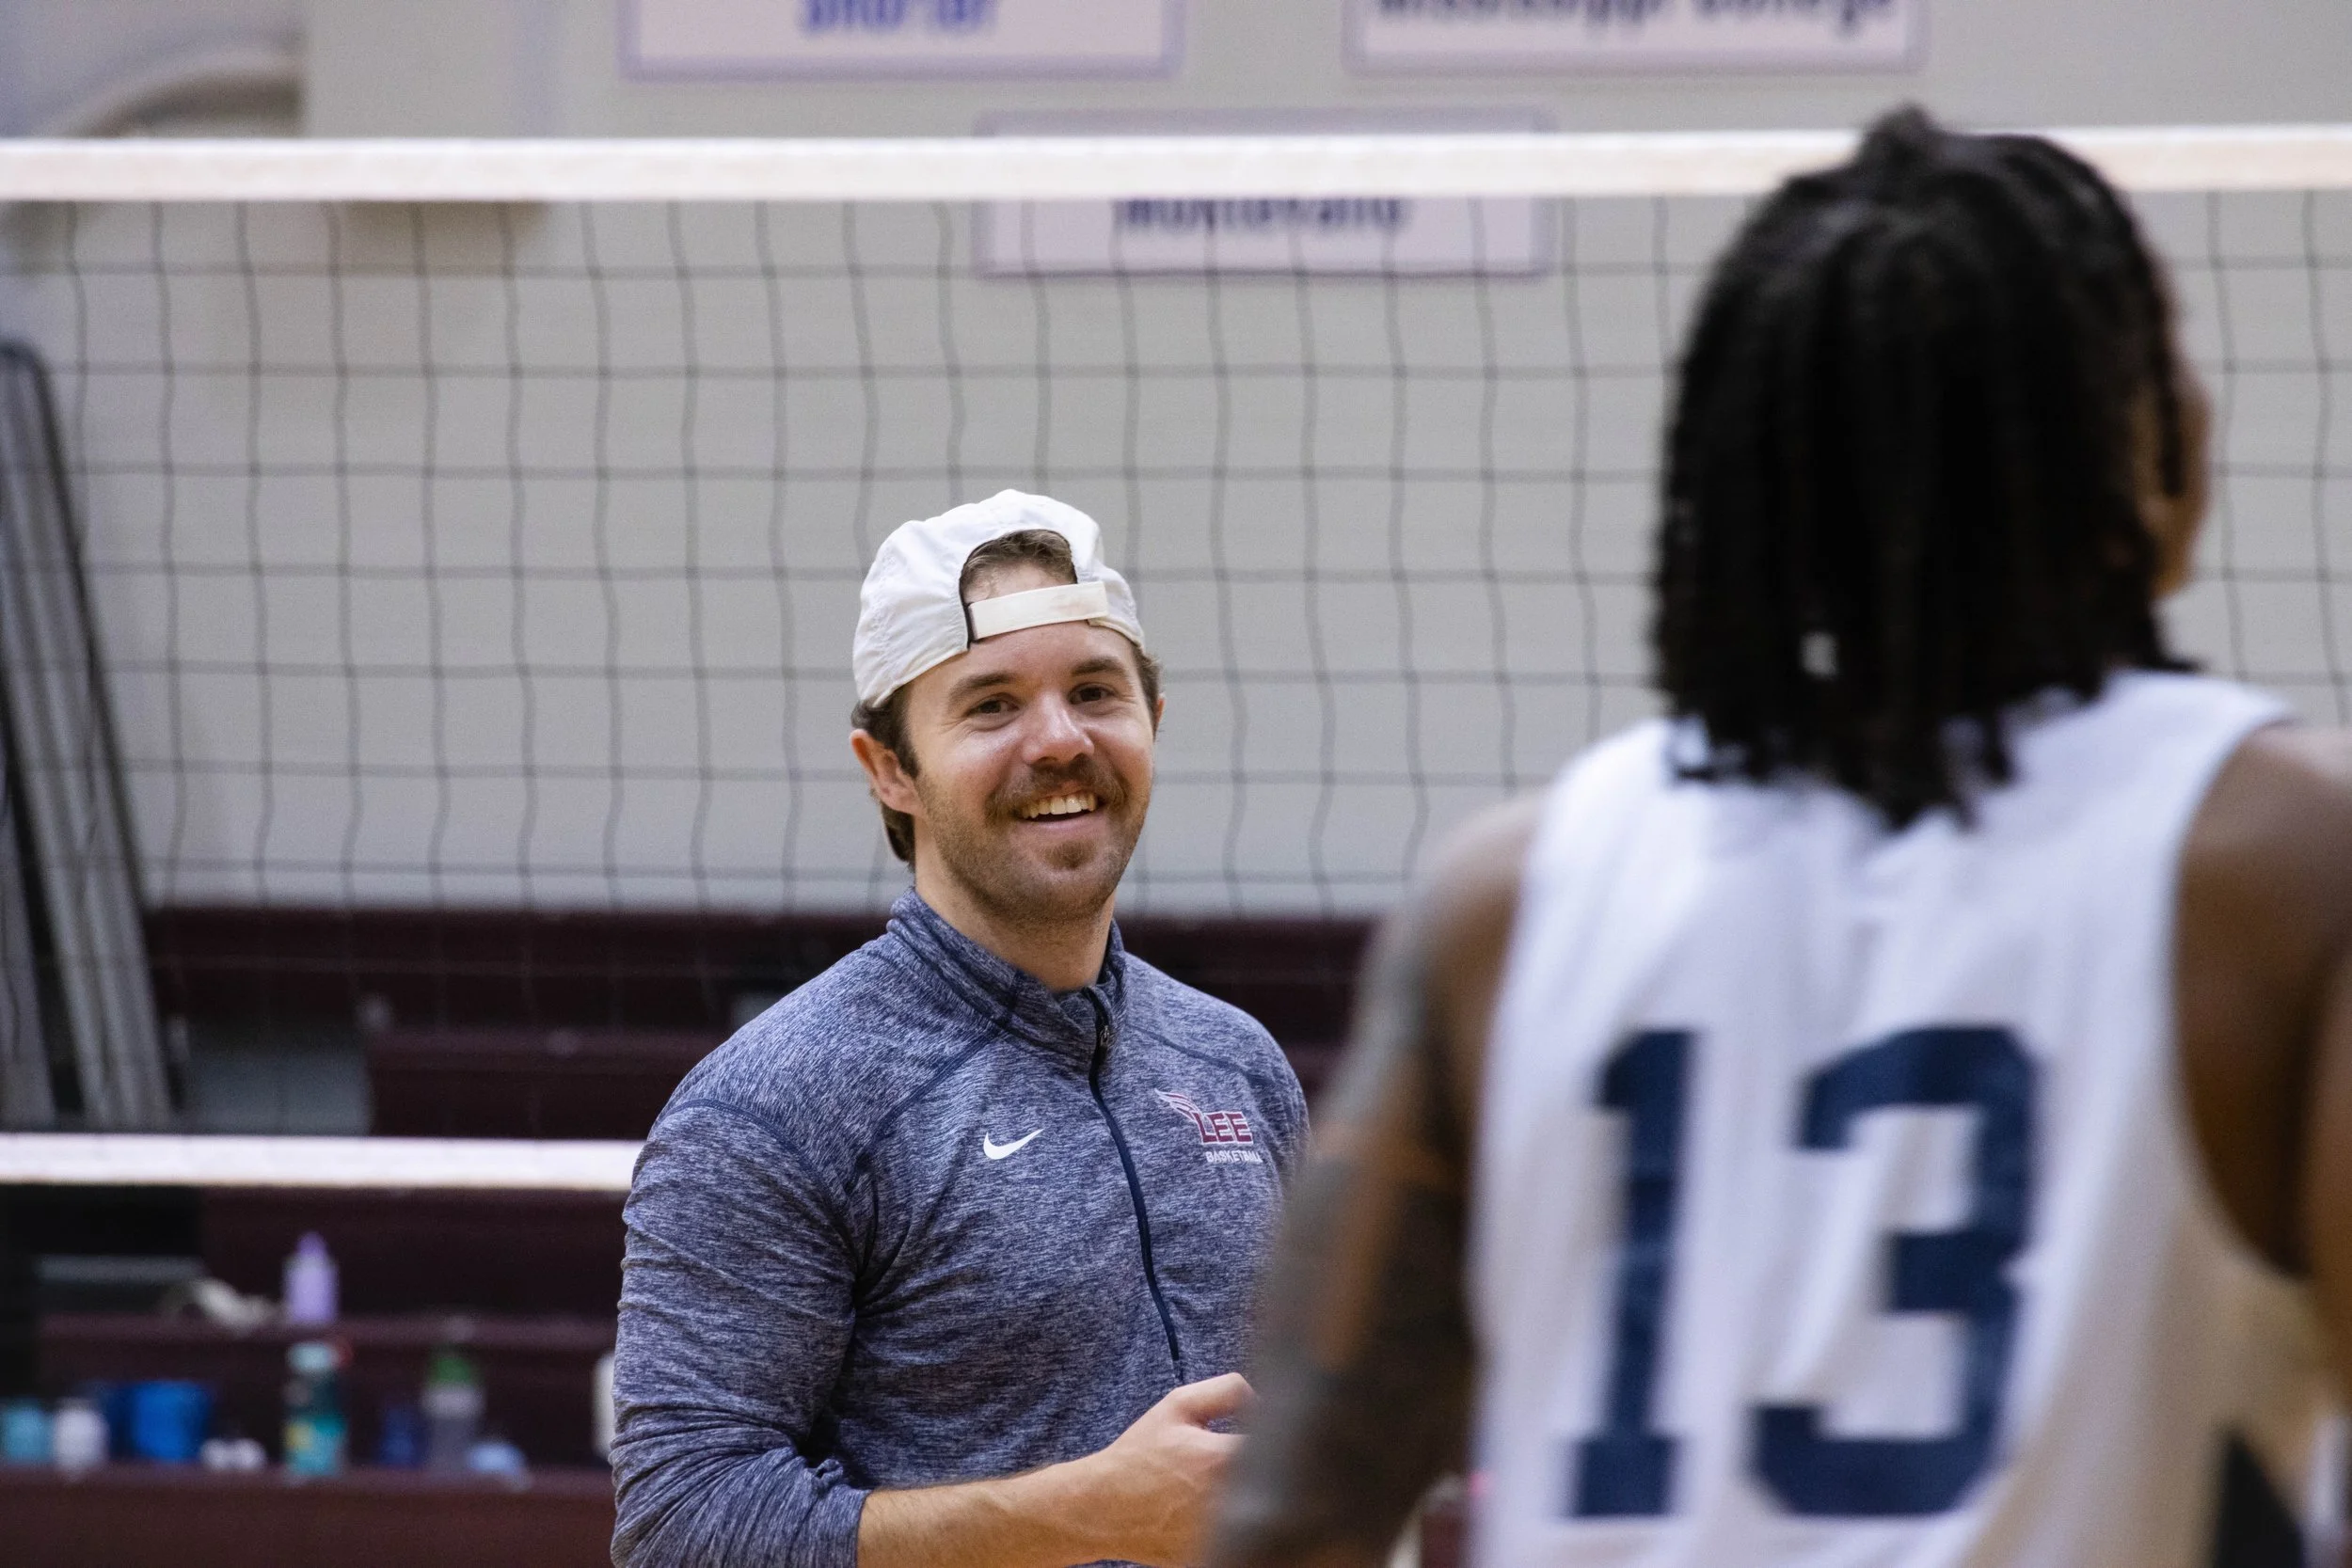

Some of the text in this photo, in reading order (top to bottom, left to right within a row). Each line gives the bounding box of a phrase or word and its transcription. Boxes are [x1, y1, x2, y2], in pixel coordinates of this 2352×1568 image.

[1188, 1110, 1253, 1145] LEE
[1205, 1149, 1263, 1164] BASKETBALL
[1565, 1026, 2040, 1518] 13
